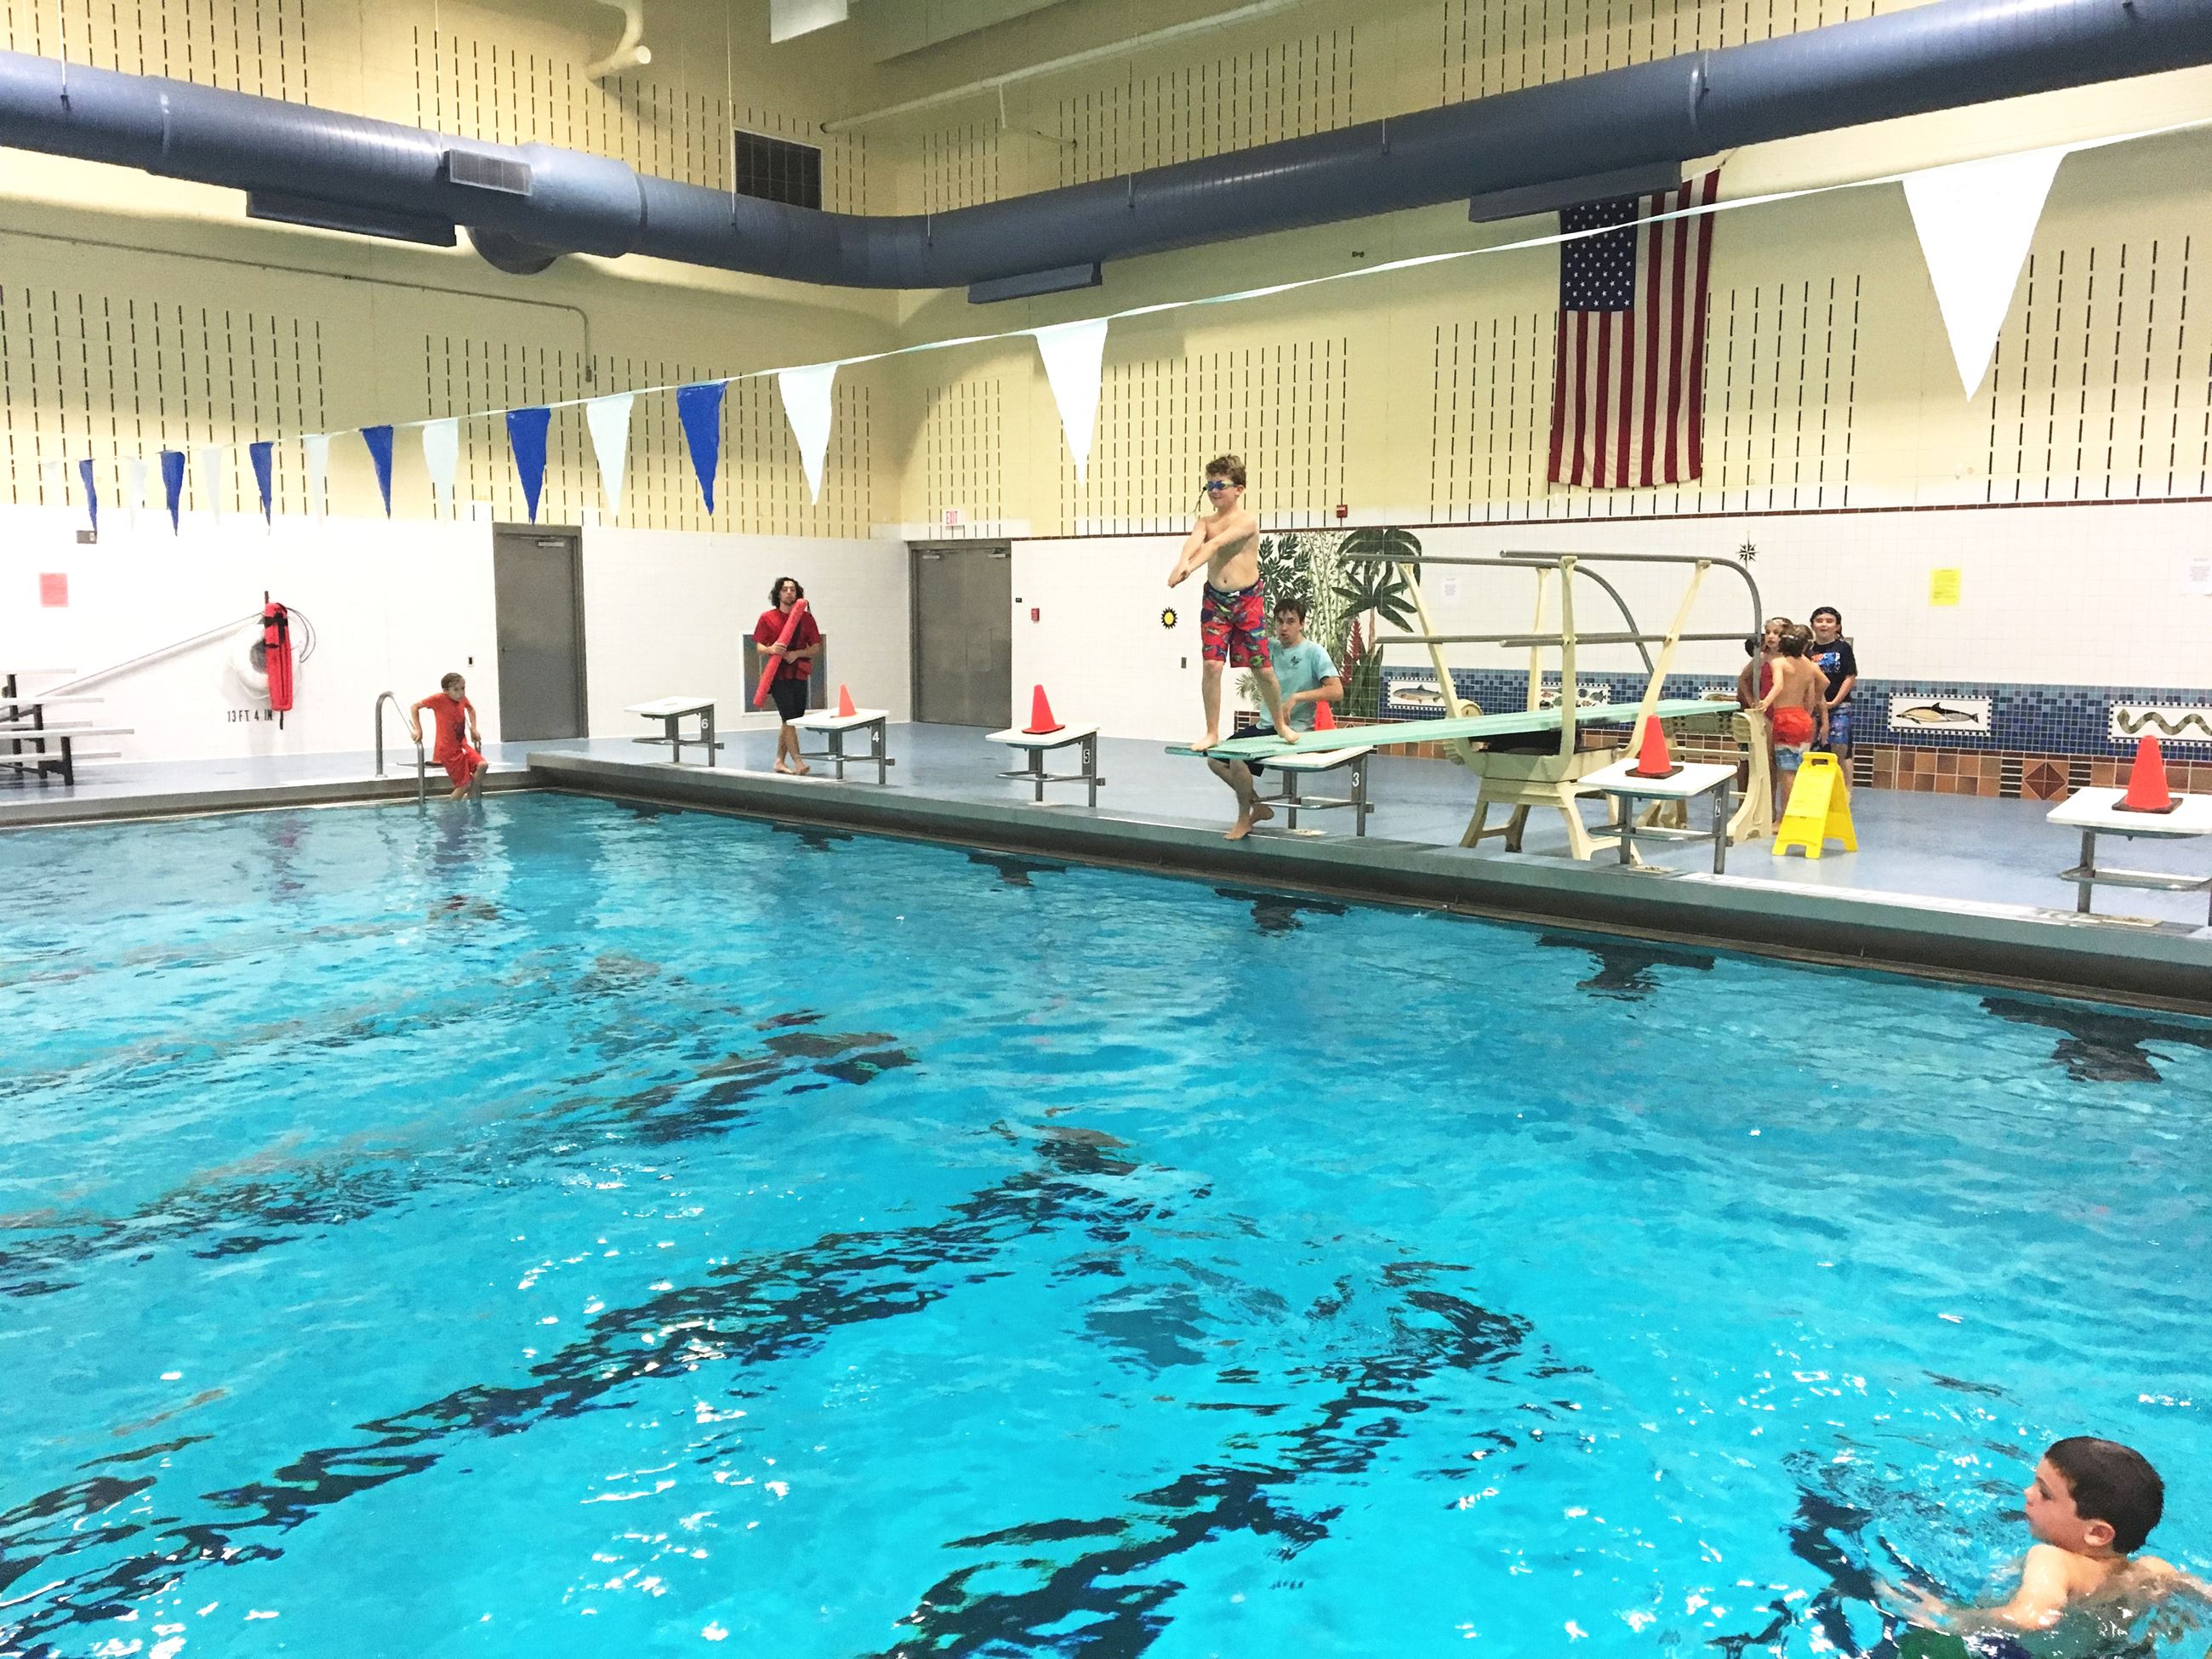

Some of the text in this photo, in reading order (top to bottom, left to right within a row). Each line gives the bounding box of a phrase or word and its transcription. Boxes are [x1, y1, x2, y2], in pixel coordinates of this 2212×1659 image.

[945, 510, 958, 525] EXIT
[254, 710, 259, 721] 4
[264, 709, 273, 721] IN
[701, 718, 709, 729] 6
[872, 731, 880, 743] 4
[1084, 750, 1090, 763] 5
[1352, 772, 1360, 787] 3
